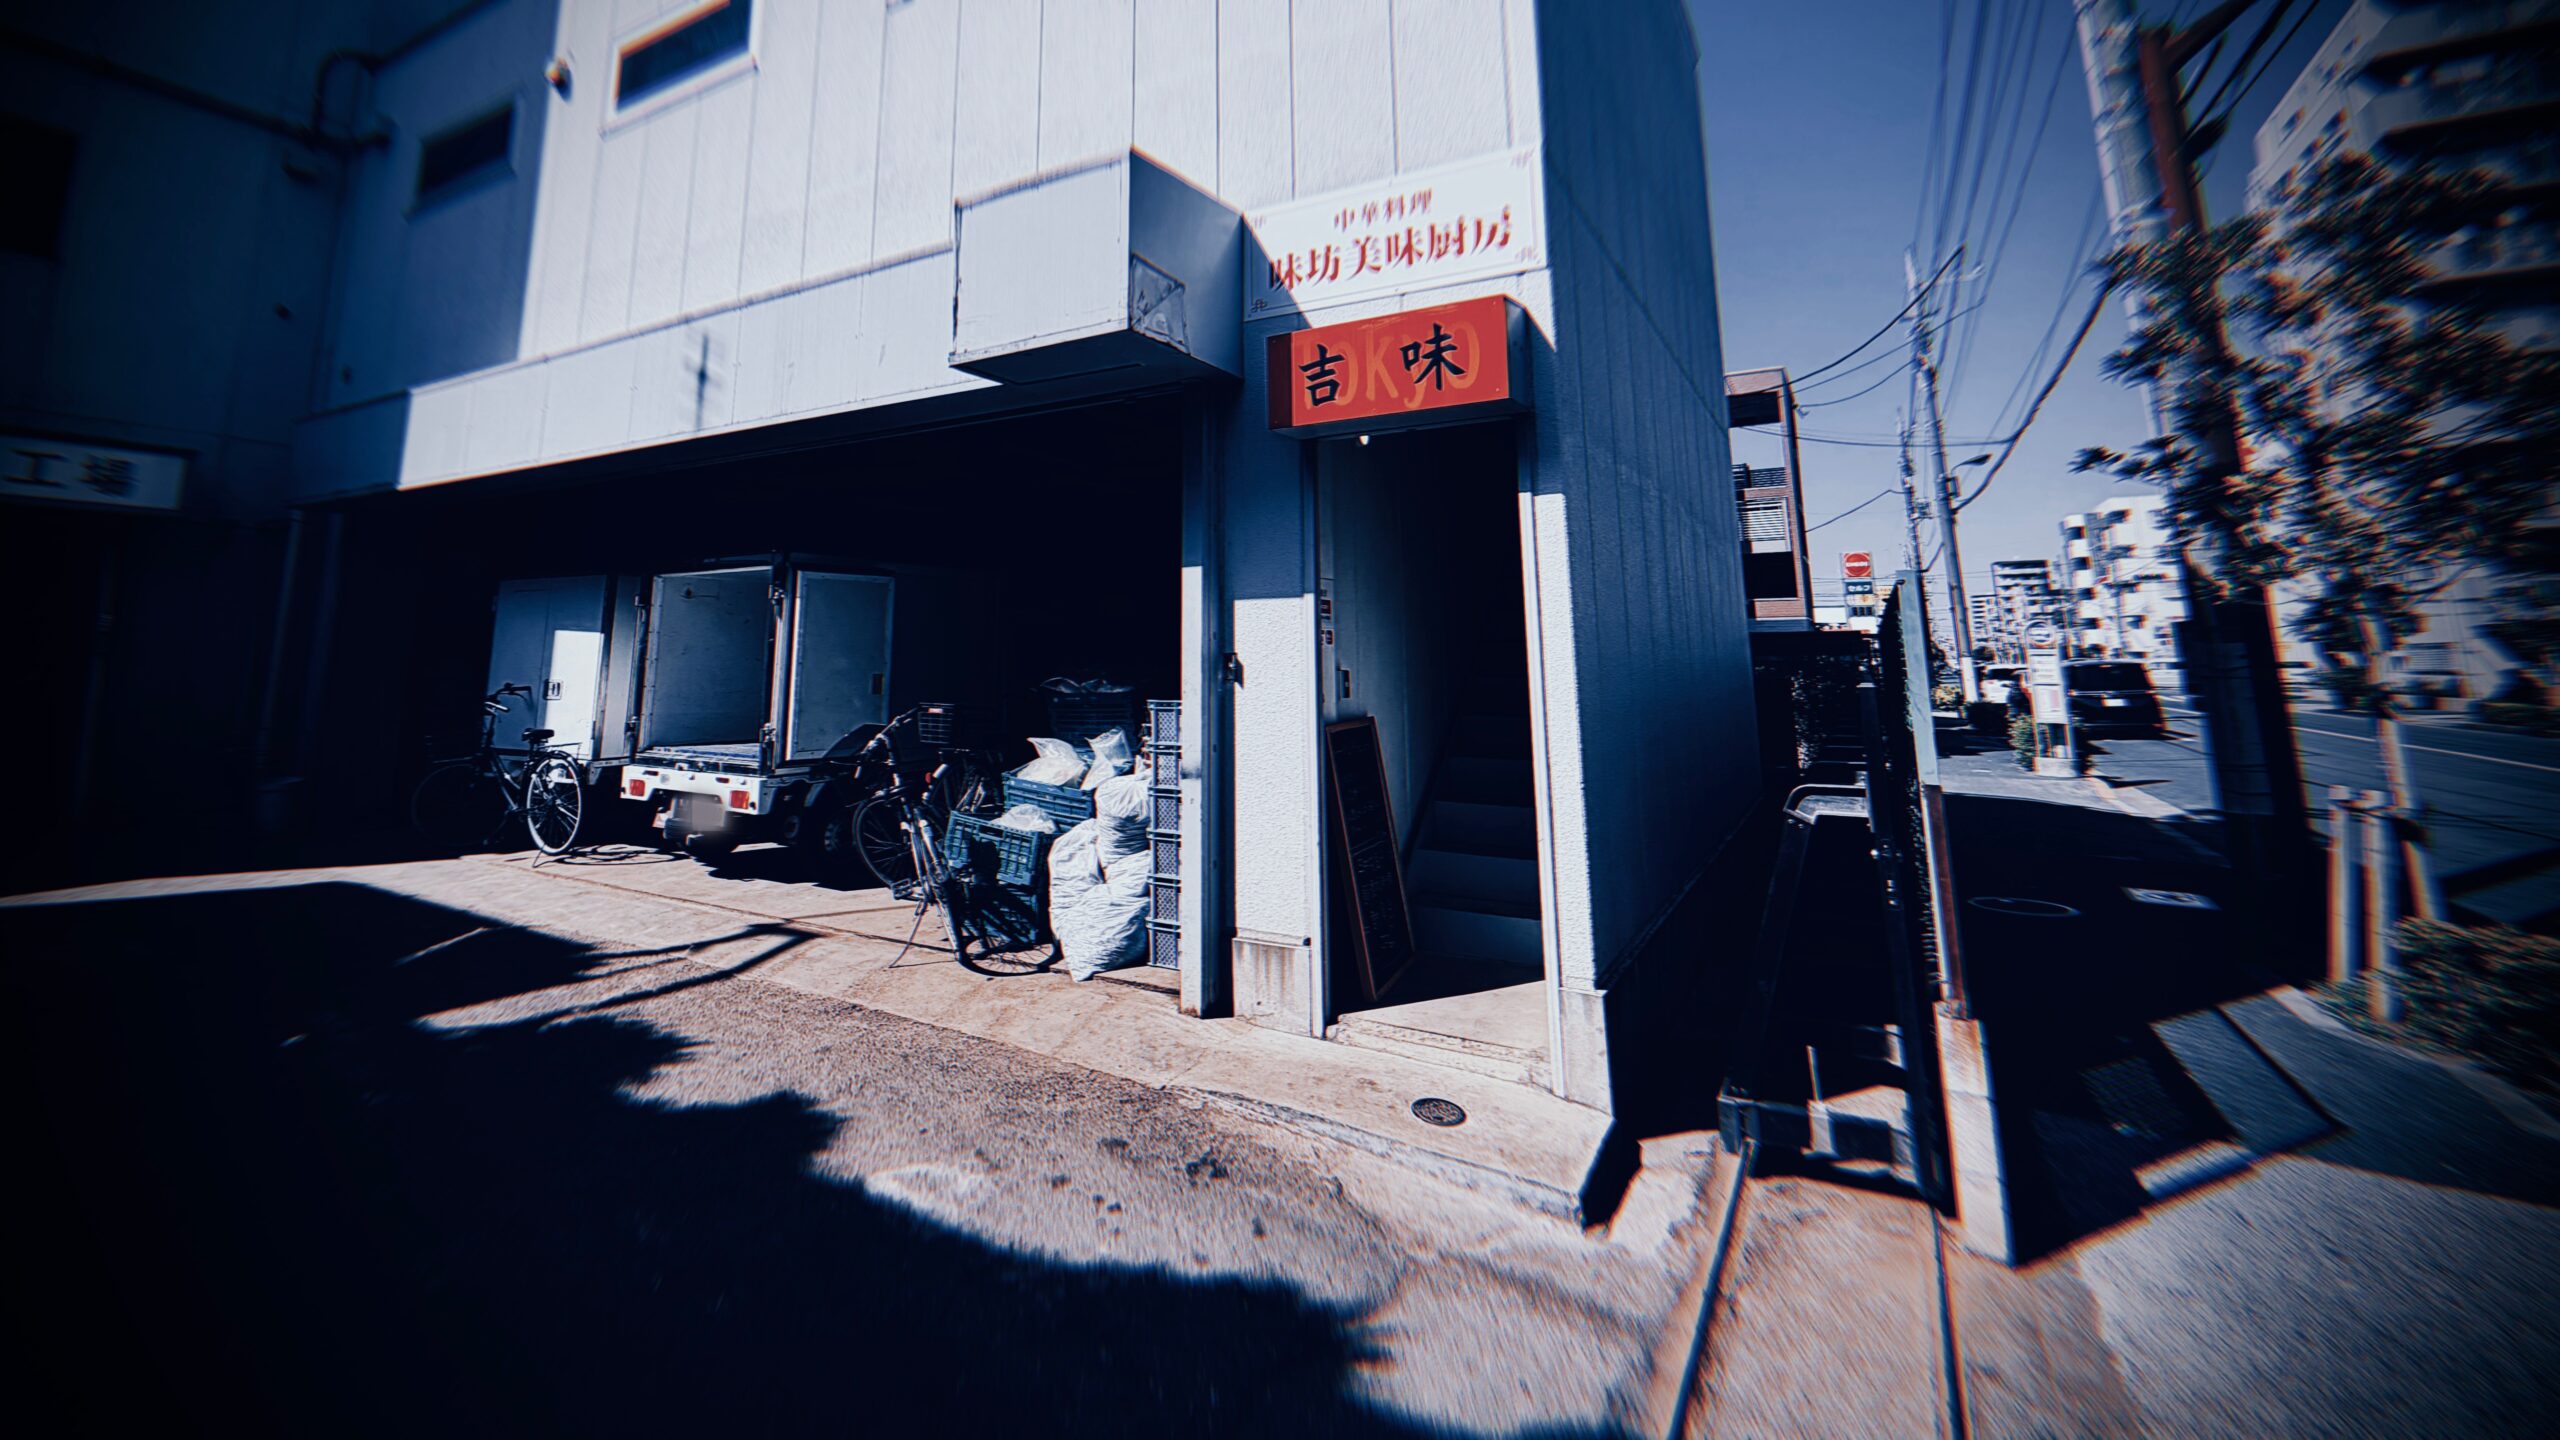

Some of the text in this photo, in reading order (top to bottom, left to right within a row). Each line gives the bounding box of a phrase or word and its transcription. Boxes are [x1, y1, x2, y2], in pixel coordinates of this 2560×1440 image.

[1269, 204, 1511, 292] 味坊美味厨房
[1299, 323, 1465, 406] 吉味
